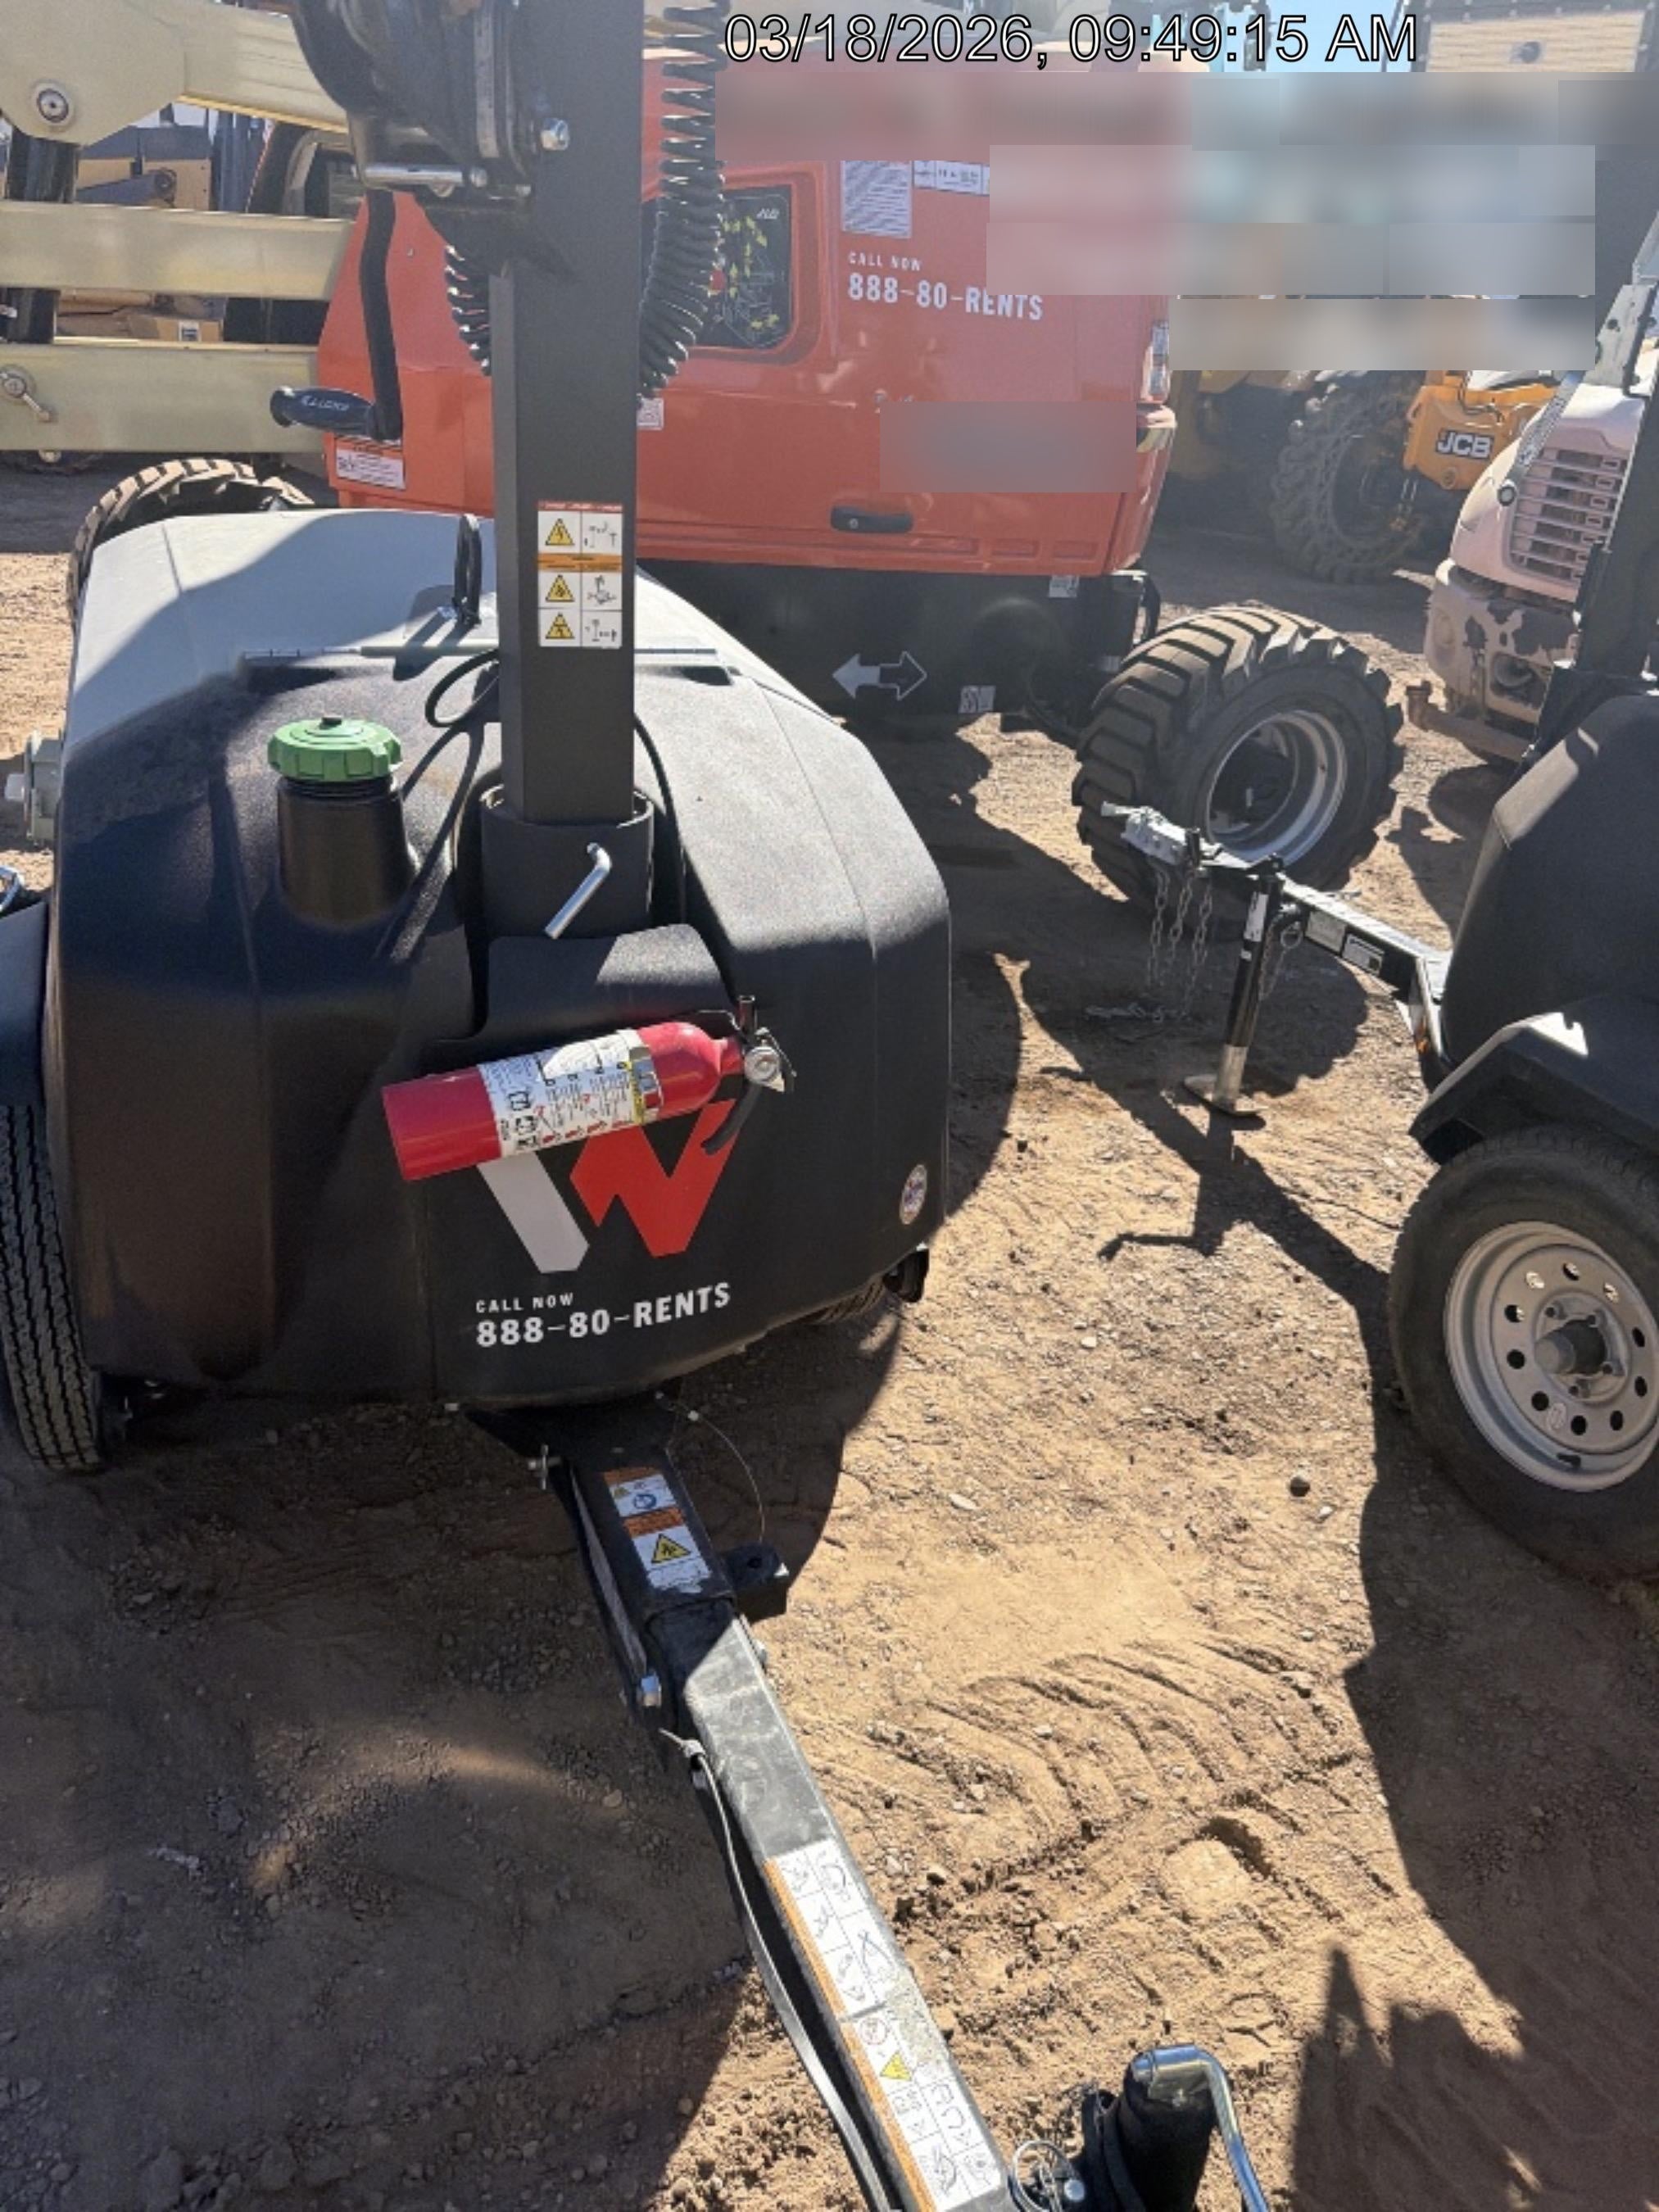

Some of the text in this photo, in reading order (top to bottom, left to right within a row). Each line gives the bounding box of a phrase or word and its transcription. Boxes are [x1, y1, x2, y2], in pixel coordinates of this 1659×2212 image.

[848, 251, 922, 271] CALL NOW
[847, 272, 1044, 321] 888-80-RENTS
[1437, 431, 1491, 459] JCB
[475, 1292, 574, 1313] CALL NOW
[476, 1281, 731, 1348] 888-80-RENTS
